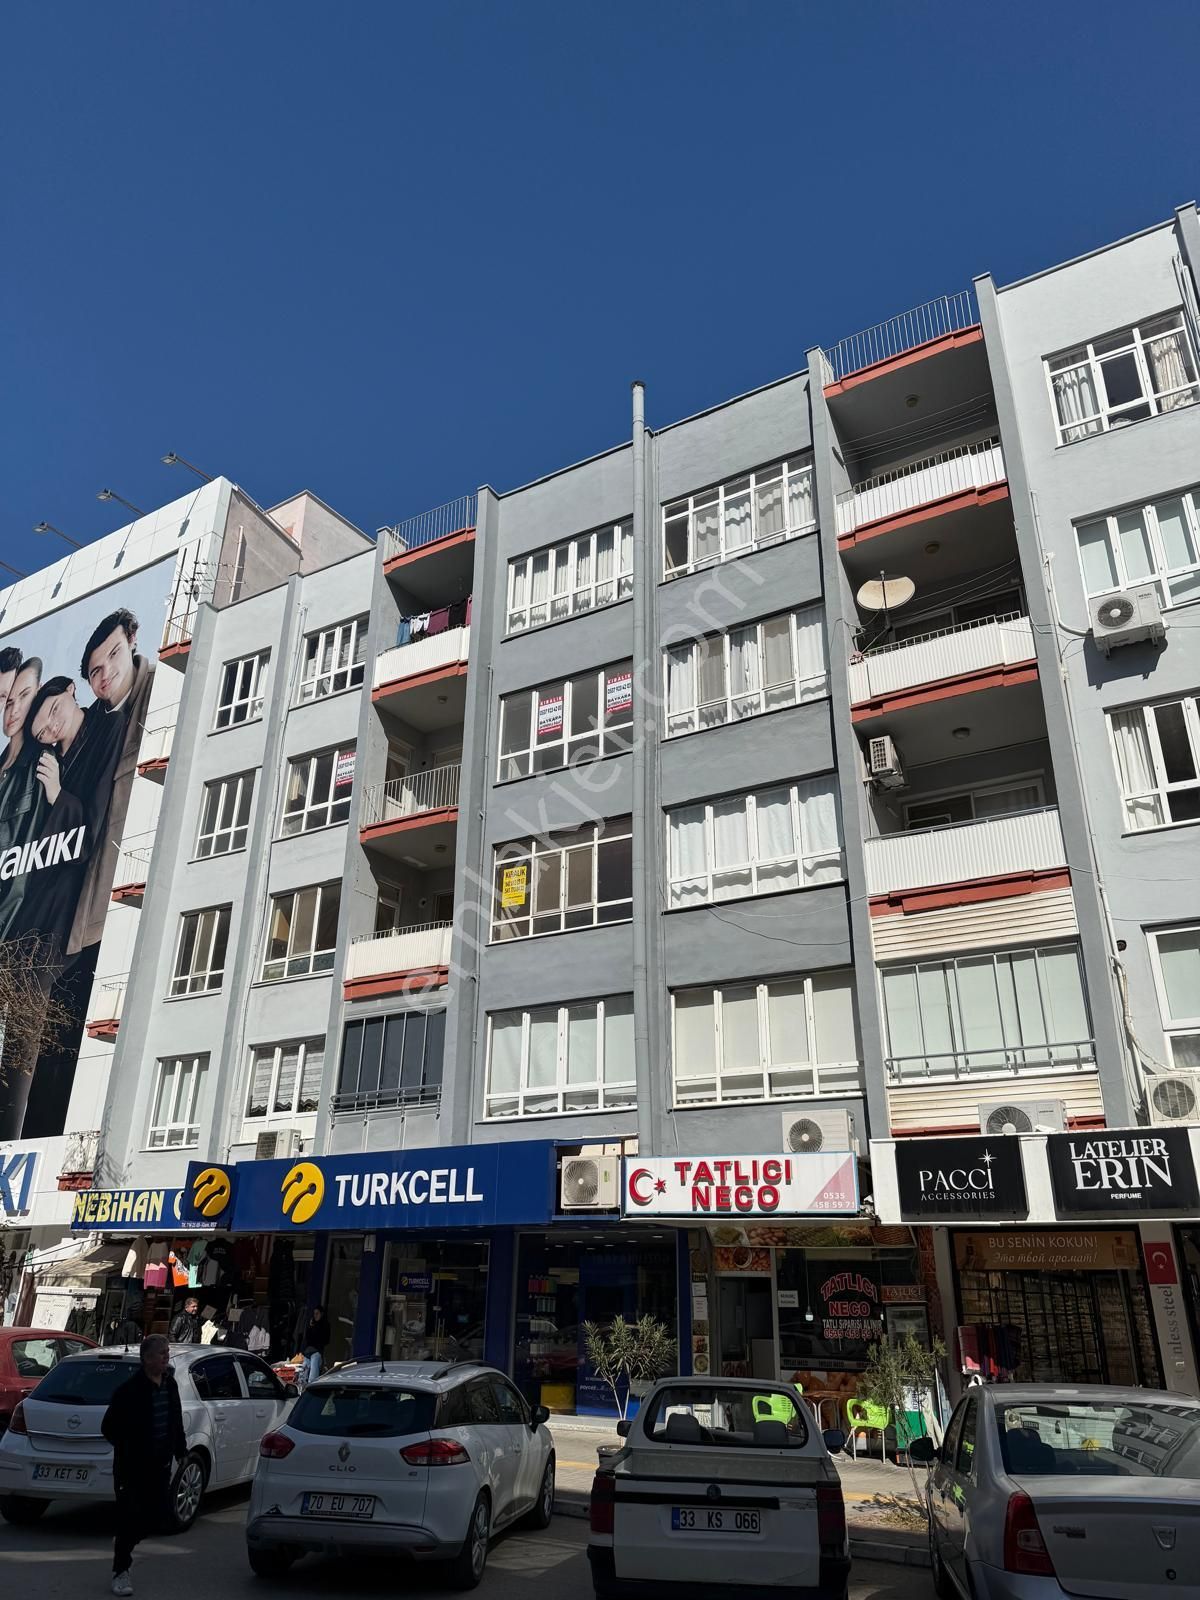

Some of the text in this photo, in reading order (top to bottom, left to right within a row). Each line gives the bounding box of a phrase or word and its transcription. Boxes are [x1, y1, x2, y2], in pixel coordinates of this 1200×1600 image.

[1069, 1138, 1169, 1160] LATELIER
[674, 1159, 793, 1186] TATLICI
[1072, 1155, 1174, 1190] ERIN
[335, 1167, 484, 1207] TURKCELL
[921, 1191, 995, 1201] ACCESSORIES
[692, 1185, 780, 1212] NECO
[832, 1201, 843, 1209] 59
[988, 1234, 1098, 1248] BU SENİN KOKUN!
[820, 1272, 878, 1303] TATLICI
[828, 1301, 871, 1317] NECO
[1158, 1285, 1177, 1317] steel
[822, 1318, 838, 1329] TATLI
[38, 1466, 51, 1478] 33
[54, 1468, 72, 1480] KET
[328, 1464, 357, 1473] CLIO
[310, 1495, 373, 1512] 70 EU 707
[680, 1510, 695, 1527] 33
[707, 1511, 723, 1528] KS
[735, 1512, 758, 1529] 066
